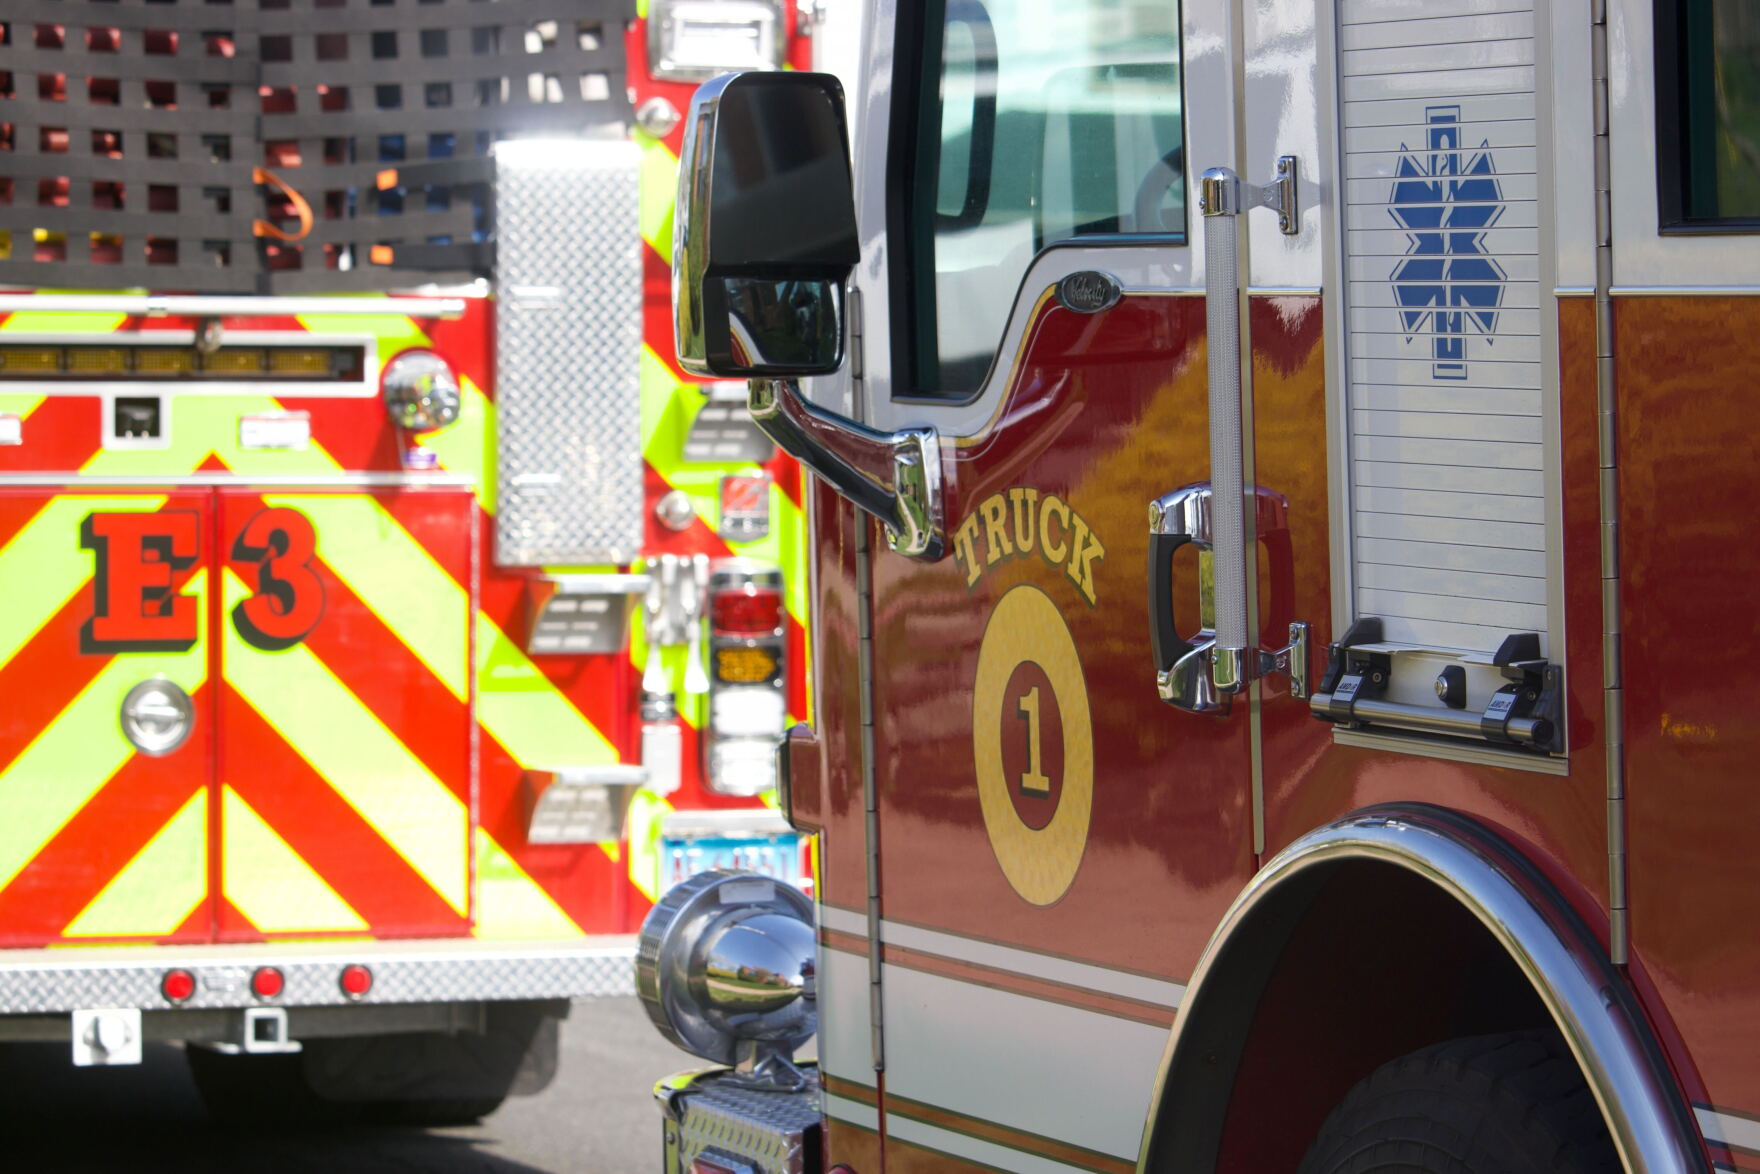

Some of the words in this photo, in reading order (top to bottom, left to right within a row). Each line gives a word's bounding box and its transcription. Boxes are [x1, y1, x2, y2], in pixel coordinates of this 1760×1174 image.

[79, 510, 200, 654] E
[230, 507, 326, 652] 3
[952, 487, 1106, 608] TRUCK
[1017, 685, 1051, 798] 1
